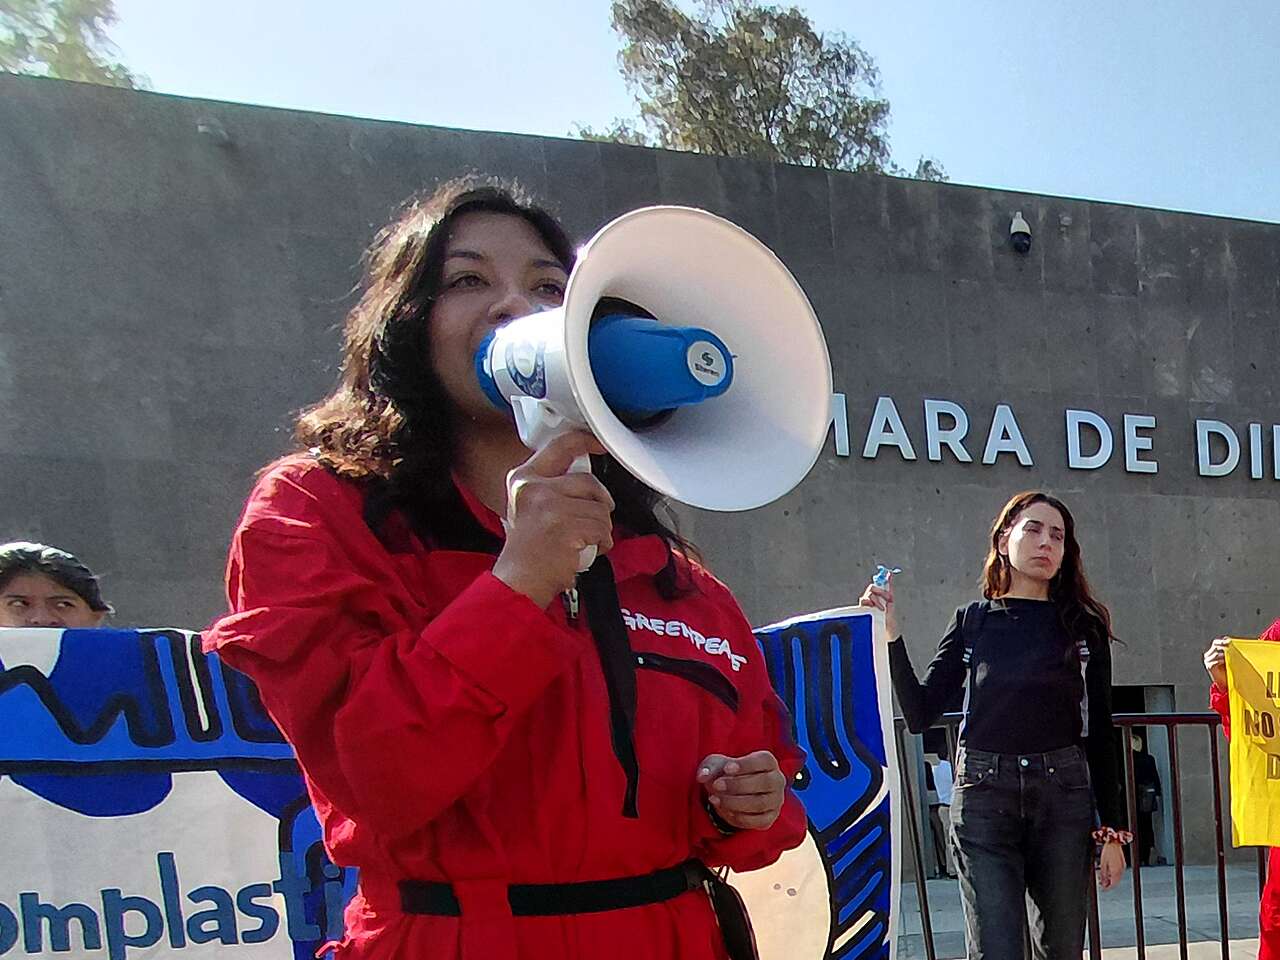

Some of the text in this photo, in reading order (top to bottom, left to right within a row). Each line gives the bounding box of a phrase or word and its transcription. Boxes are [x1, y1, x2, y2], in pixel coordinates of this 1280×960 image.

[1065, 408, 1159, 474] DE
[620, 608, 748, 672] GREENPEAE
[1244, 710, 1275, 739] NO
